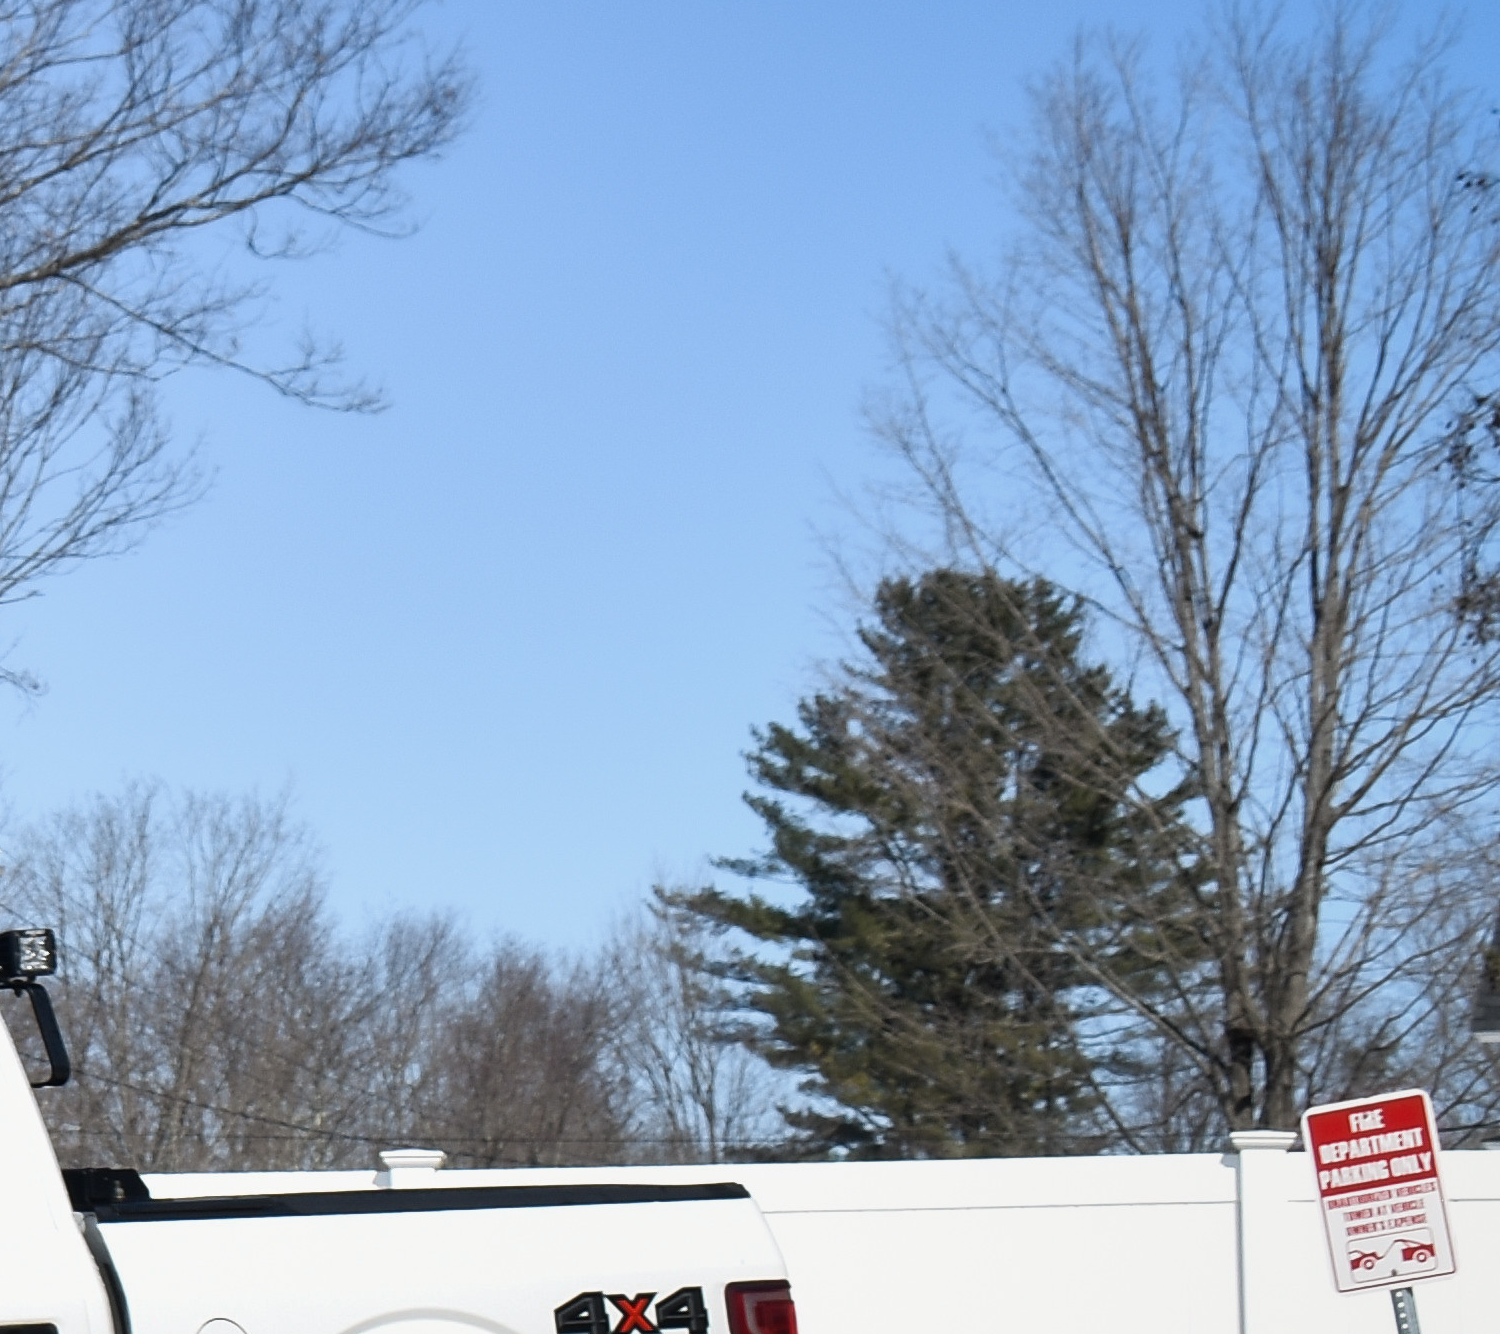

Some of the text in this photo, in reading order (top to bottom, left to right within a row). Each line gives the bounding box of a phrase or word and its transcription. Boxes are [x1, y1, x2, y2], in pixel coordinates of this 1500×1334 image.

[1348, 1109, 1386, 1134] FIRE
[1318, 1127, 1423, 1164] DEPARTMENT
[1318, 1151, 1432, 1190] PARKING ONLY
